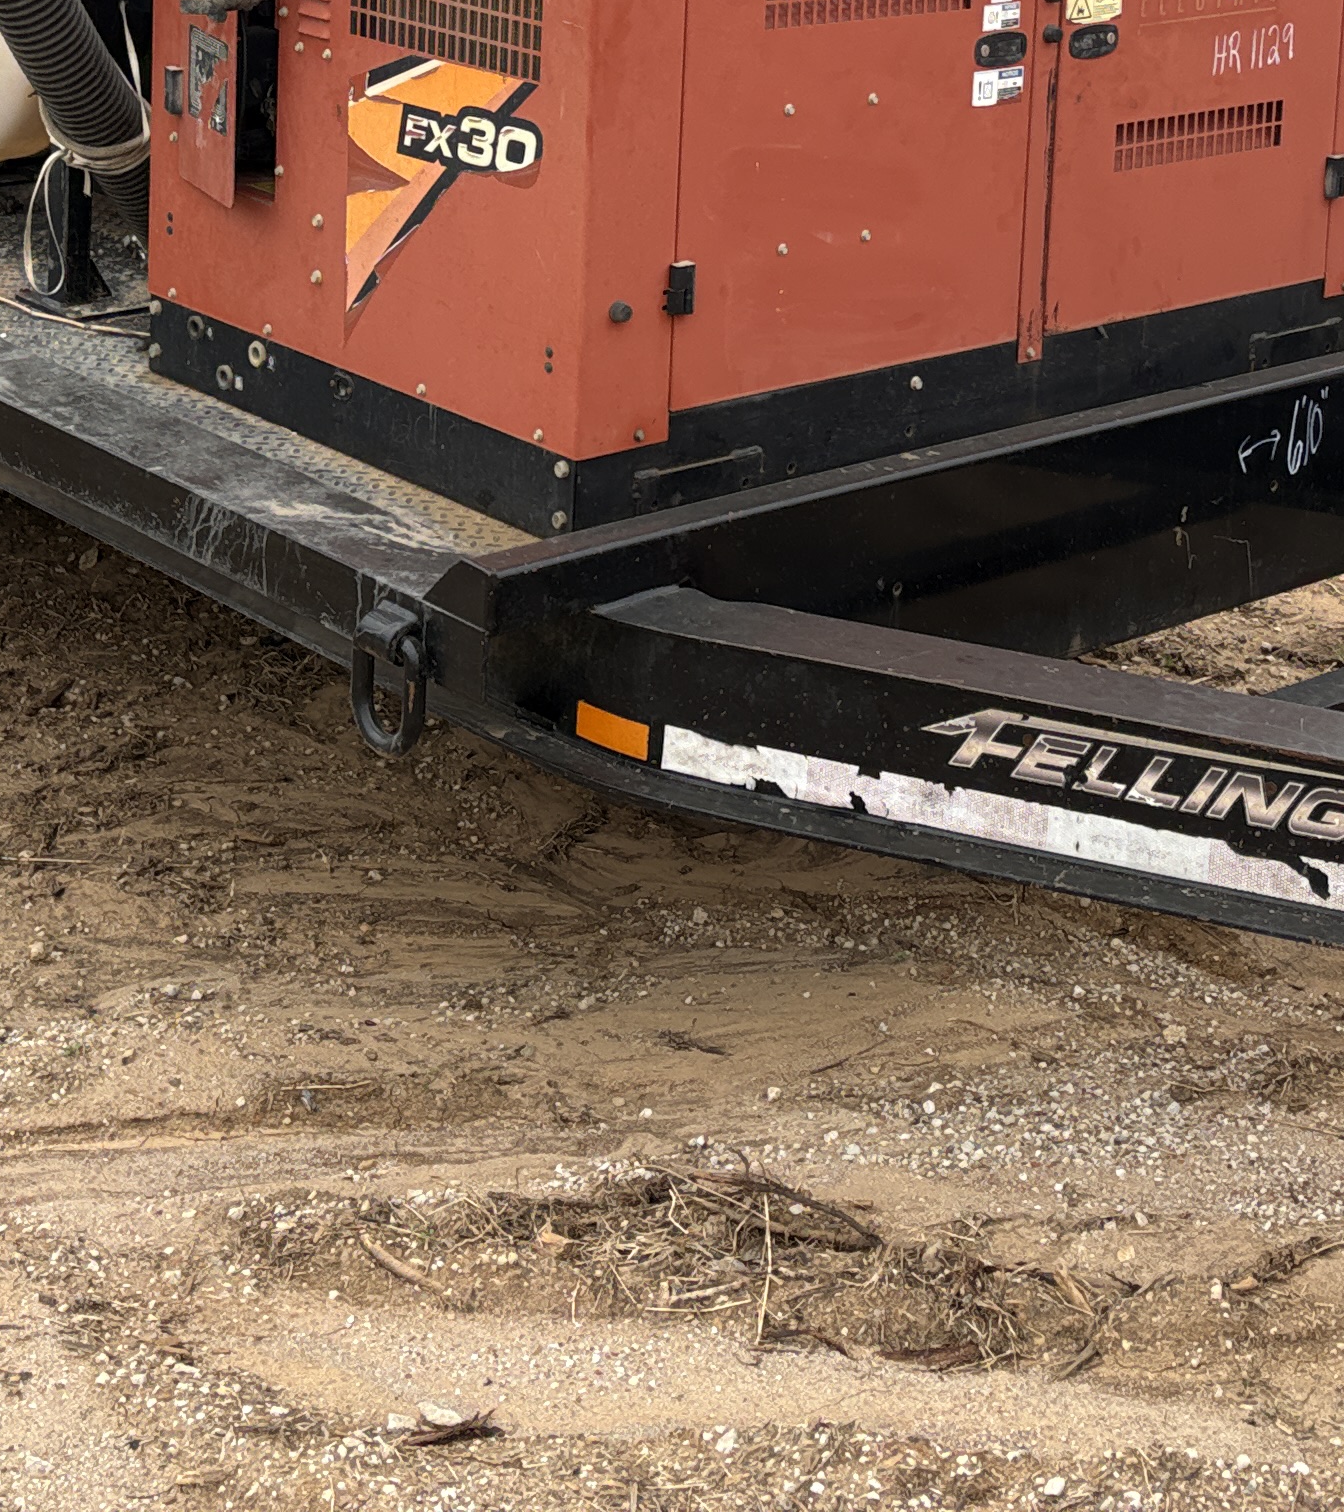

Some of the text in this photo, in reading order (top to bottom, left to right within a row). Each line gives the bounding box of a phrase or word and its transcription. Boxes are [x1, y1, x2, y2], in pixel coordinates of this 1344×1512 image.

[1212, 23, 1294, 76] HR 1129
[404, 114, 537, 172] FX30
